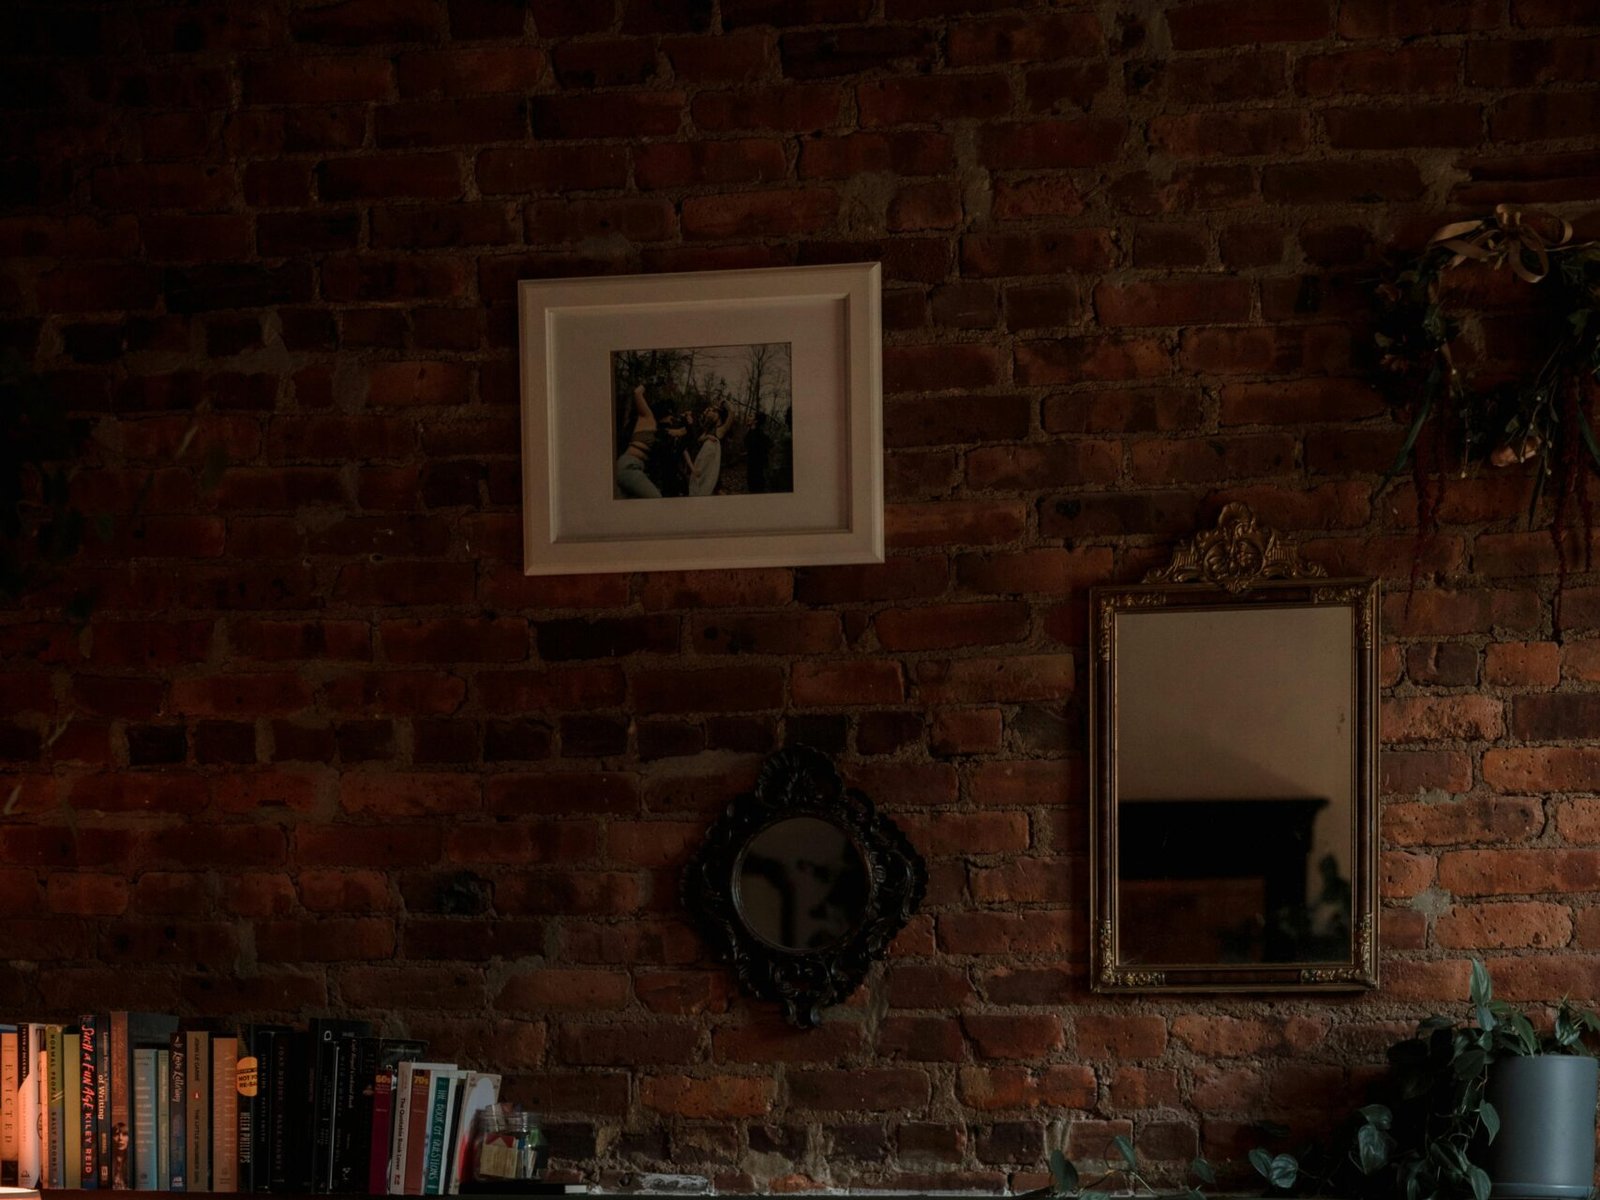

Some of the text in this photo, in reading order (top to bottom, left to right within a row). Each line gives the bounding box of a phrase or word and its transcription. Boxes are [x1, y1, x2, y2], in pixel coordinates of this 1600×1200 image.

[98, 1075, 105, 1084] of
[172, 1052, 184, 1102] Love Lettering
[5, 1064, 13, 1143] EVICTED
[82, 1086, 96, 1110] AGE
[435, 1104, 445, 1122] BOOK
[240, 1112, 251, 1164] HELEN PHILLIPS
[429, 1139, 441, 1180] QUESTIONS
